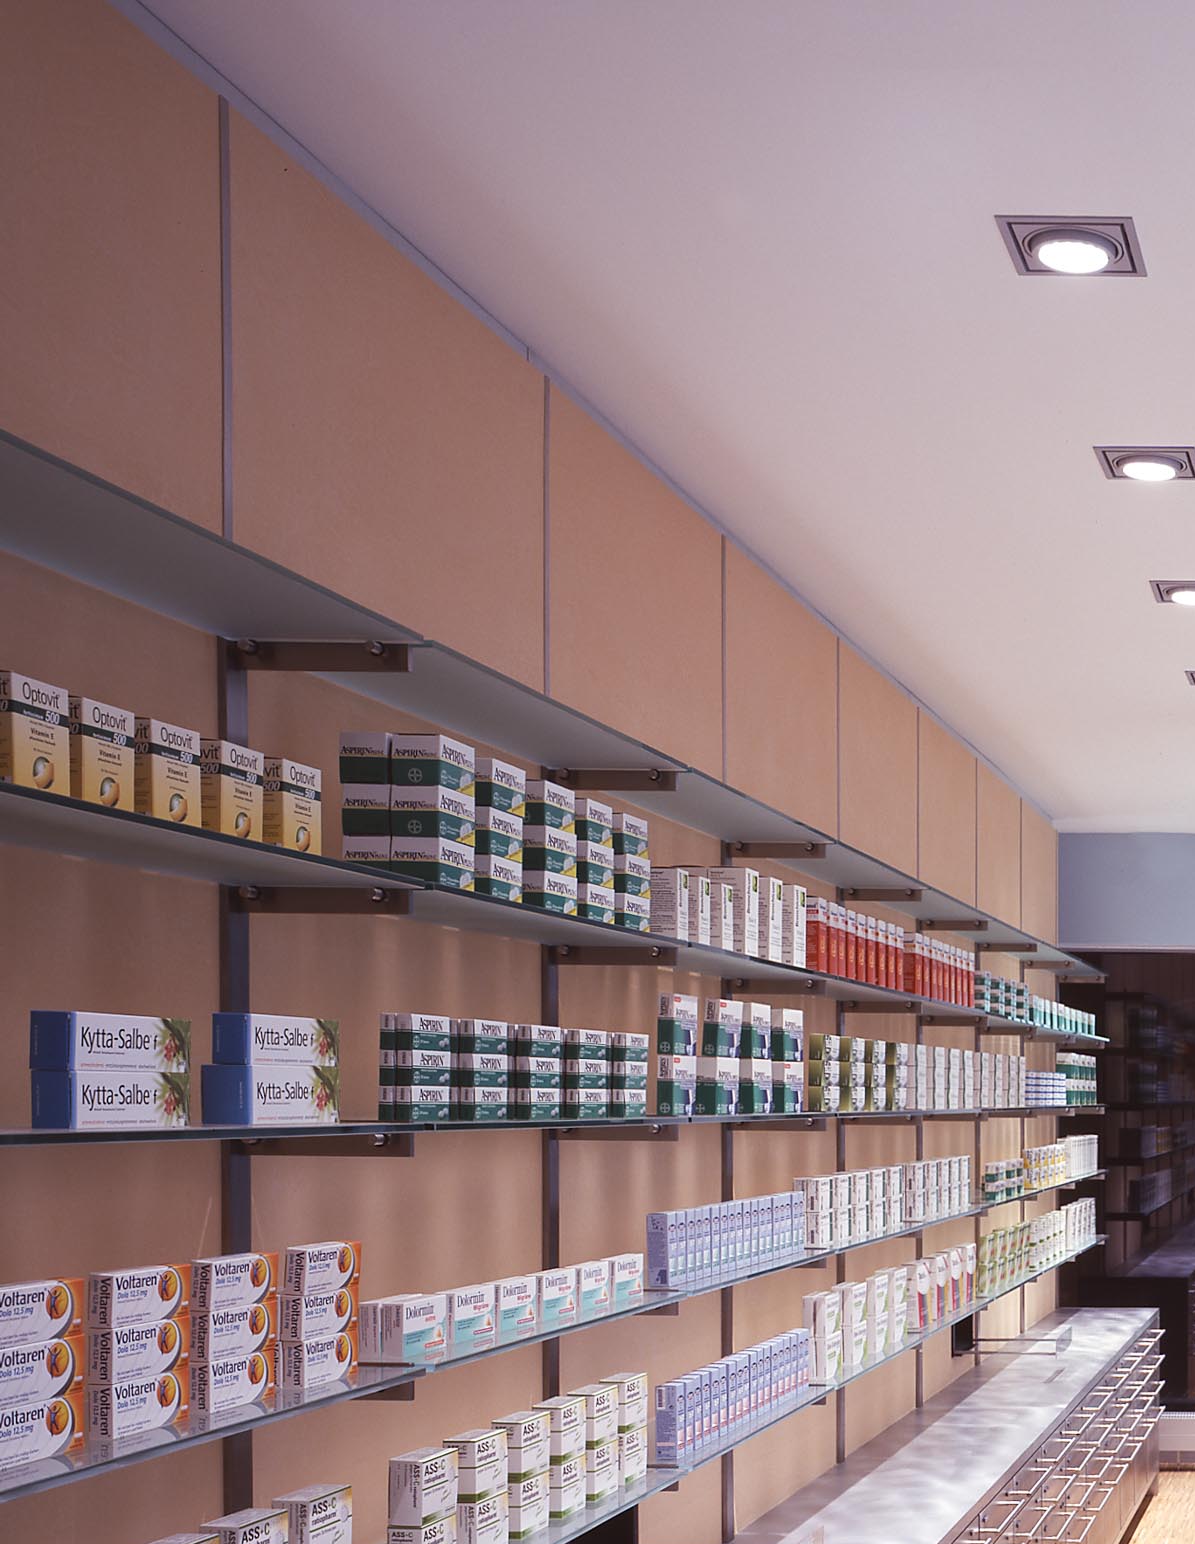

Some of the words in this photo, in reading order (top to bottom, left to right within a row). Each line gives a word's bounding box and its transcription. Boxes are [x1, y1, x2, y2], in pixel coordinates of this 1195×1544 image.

[23, 682, 59, 709] Optovit
[45, 711, 60, 725] 500
[93, 706, 127, 731] Optovit
[30, 728, 50, 738] Vitamin
[113, 733, 127, 746] 500
[160, 727, 192, 750] Optovit
[99, 750, 116, 760] Vitamin
[180, 752, 193, 764] 500
[230, 748, 258, 770] Optovit
[442, 744, 464, 765] ASPIRIN
[246, 772, 257, 784] 500
[290, 766, 316, 787] Optovit
[494, 767, 516, 787] ASPIRIN
[304, 788, 316, 800] 500
[440, 795, 465, 816] ASPIRIN
[492, 816, 514, 834] ASPIRIN
[441, 846, 465, 866] ASPIRIN
[493, 864, 515, 882] ASPIRIN
[420, 1017, 444, 1032] ASPIRIN
[81, 1026, 150, 1054] Kytta-Salbe
[154, 1034, 158, 1050] f
[255, 1026, 308, 1050] Kytta-Salbe
[310, 1033, 314, 1046] f
[421, 1052, 444, 1068] ASPIRIN
[82, 1084, 150, 1111] Kytta-Salbe
[154, 1090, 158, 1105] f
[256, 1081, 308, 1105] Kytta-Salbe
[420, 1088, 444, 1102] ASPIRIN
[308, 1250, 338, 1263] Voltaren
[214, 1262, 250, 1276] Voltaren
[294, 1252, 304, 1292] Voltaren
[115, 1275, 157, 1291] Voltaren
[200, 1264, 210, 1308] Voltaren
[502, 1282, 528, 1298] Dolormin
[100, 1278, 110, 1326] Voltaren
[304, 1294, 334, 1309] Voltaren
[458, 1291, 484, 1308] Dolormin
[212, 1312, 248, 1326] Voltaren
[291, 1298, 300, 1338] Voltaren
[406, 1302, 434, 1320] Dolormin
[115, 1328, 156, 1345] Voltaren
[198, 1316, 209, 1359] Voltaren
[100, 1332, 110, 1381] Voltaren
[117, 1346, 128, 1354] Dolo
[306, 1340, 335, 1355] Voltaren
[212, 1360, 247, 1377] Voltaren
[293, 1344, 302, 1386] Voltaren
[114, 1380, 156, 1400] Voltaren
[198, 1366, 209, 1410] Voltaren
[100, 1389, 110, 1436] Voltaren
[117, 1402, 128, 1410] Dolo
[312, 1496, 337, 1518] ASS+C
[312, 1510, 336, 1526] ratiopharm
[242, 1522, 270, 1544] ASS+C
